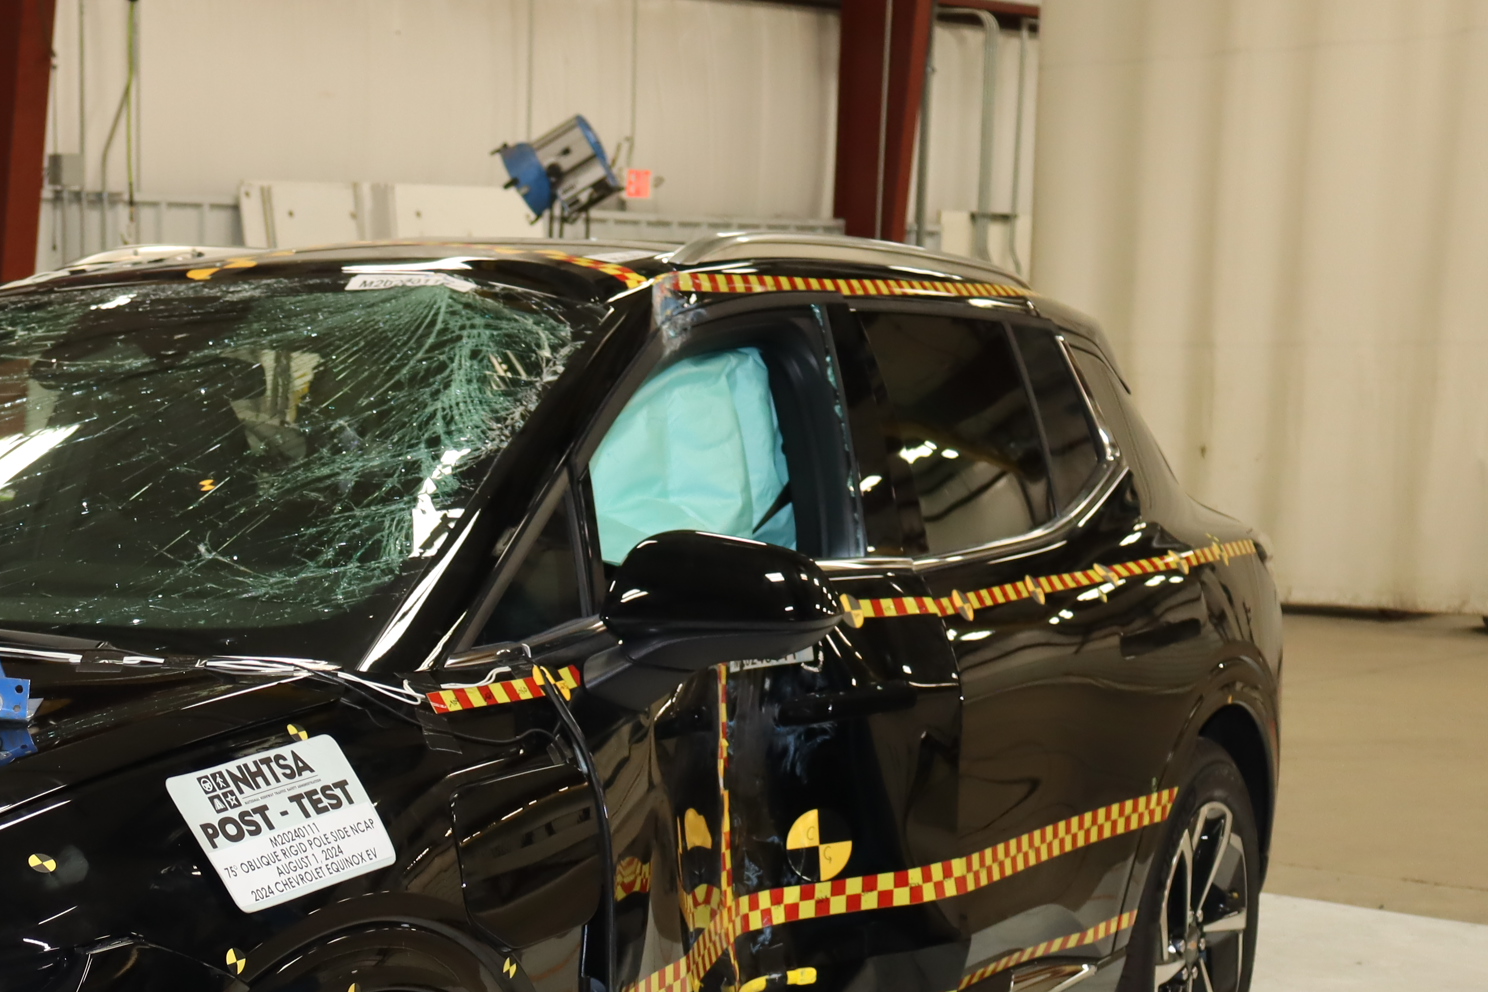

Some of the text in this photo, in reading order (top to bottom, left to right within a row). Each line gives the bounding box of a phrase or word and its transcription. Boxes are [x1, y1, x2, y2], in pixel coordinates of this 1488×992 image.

[225, 750, 315, 795] NHTSA
[199, 804, 276, 849] POST
[287, 779, 355, 819] TEST
[269, 822, 321, 848] M20240111
[240, 850, 282, 875] OBLIQUE
[282, 840, 308, 860] RIGID
[308, 833, 331, 850] POLE
[332, 827, 353, 844] SIDE
[350, 818, 375, 837] NCAP
[276, 855, 311, 877] AUGUST
[322, 845, 344, 861] 2024
[251, 848, 378, 902] 2024 CHEVROLET EQUINOX EV
